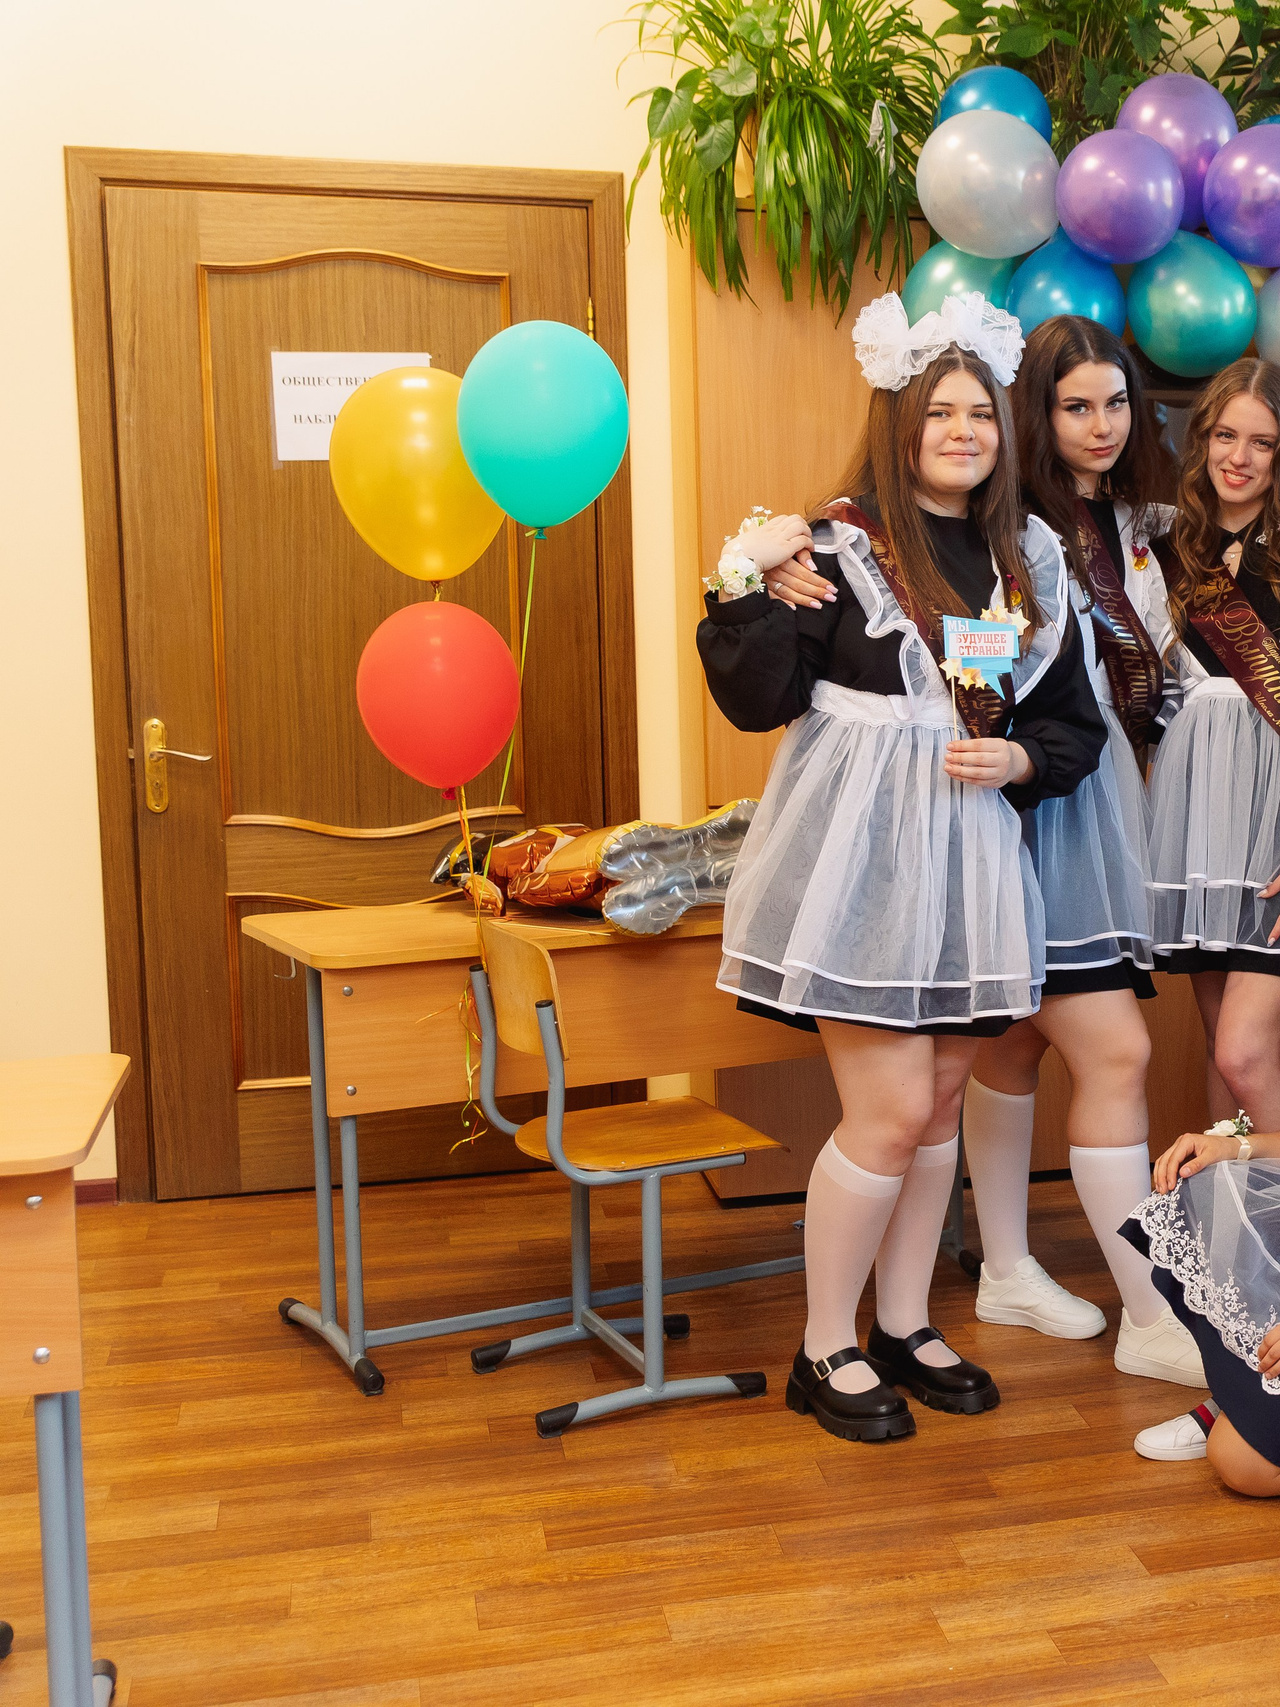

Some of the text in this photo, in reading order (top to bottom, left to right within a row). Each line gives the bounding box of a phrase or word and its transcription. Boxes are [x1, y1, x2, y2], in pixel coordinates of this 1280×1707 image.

[294, 414, 337, 425] НАБЛ
[947, 620, 970, 633] МЫ
[956, 633, 1007, 645] БУДУЩЕЕ
[1089, 562, 1148, 717] Выпускница
[958, 646, 1006, 656] СТРАНЫ!
